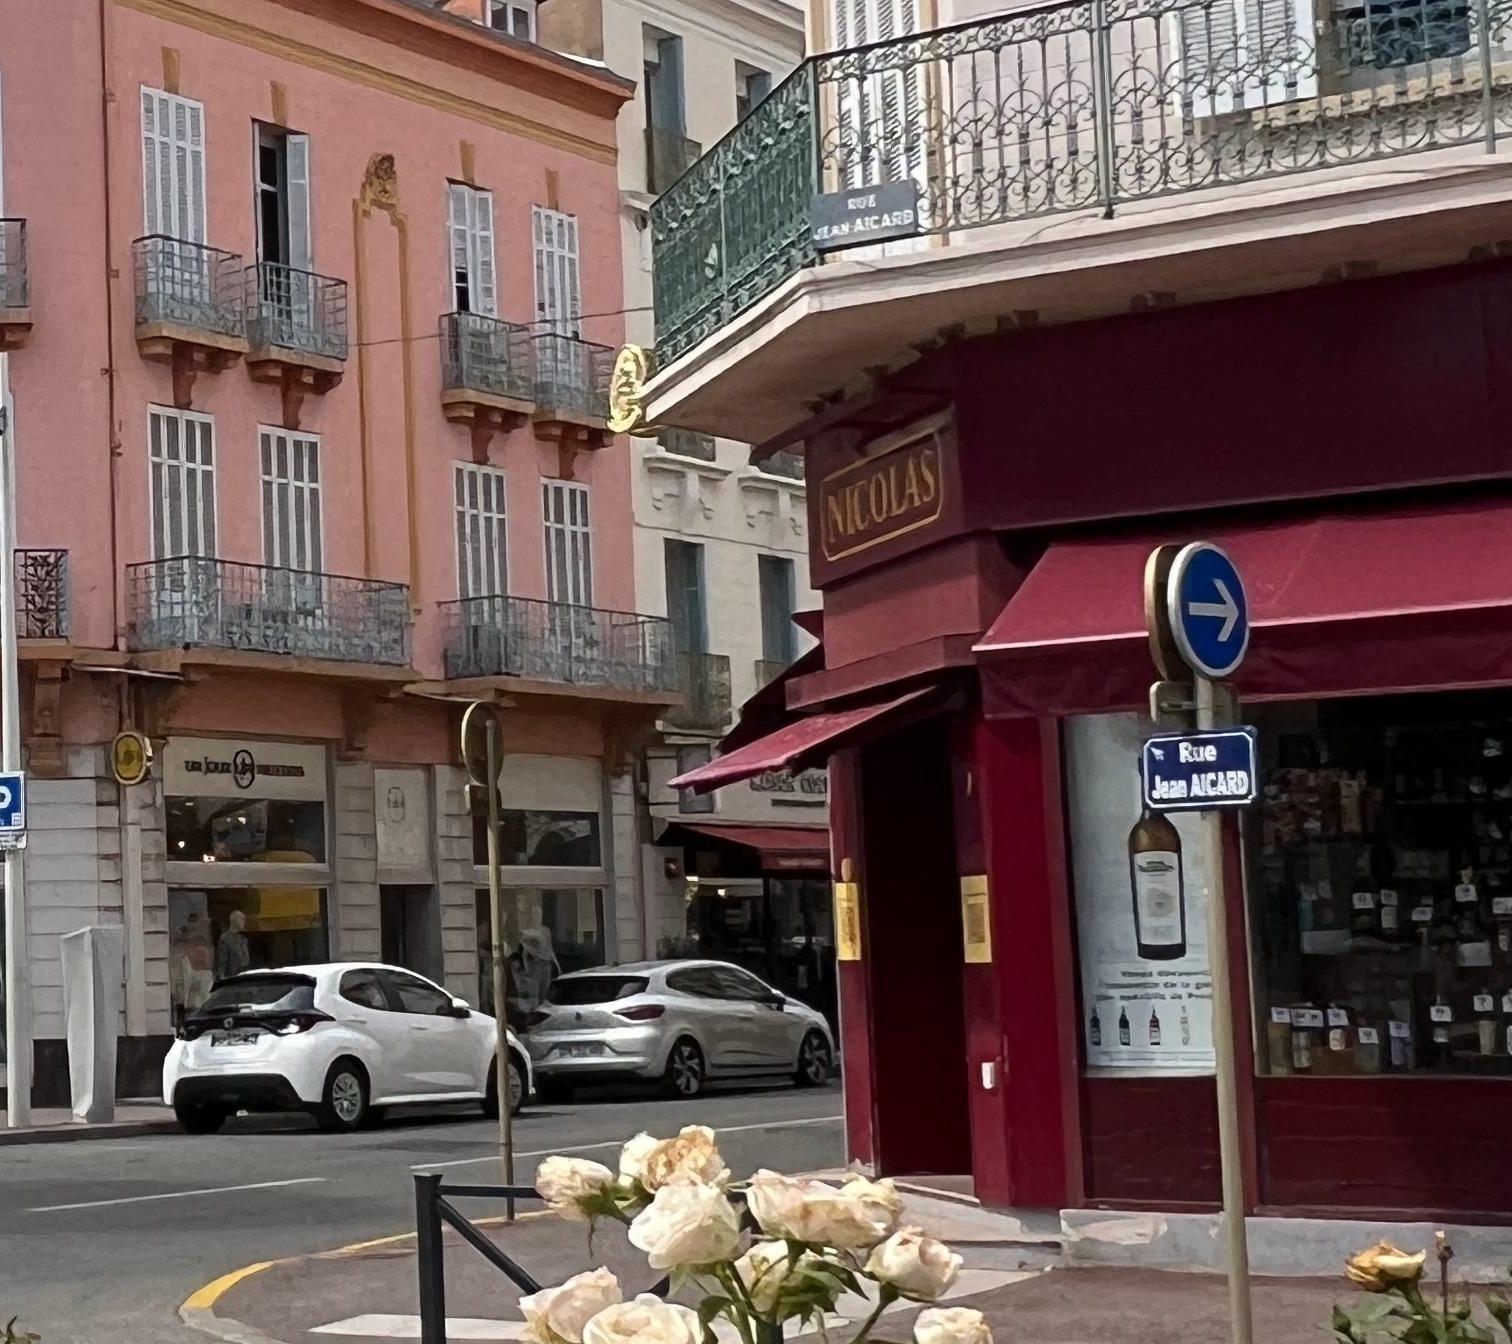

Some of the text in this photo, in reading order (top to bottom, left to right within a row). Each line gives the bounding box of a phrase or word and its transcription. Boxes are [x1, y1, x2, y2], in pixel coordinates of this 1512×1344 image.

[854, 209, 914, 233] AICARD
[827, 449, 935, 543] NICOLAS
[1179, 741, 1217, 763] Rue
[1152, 770, 1249, 799] Jean AICARD
